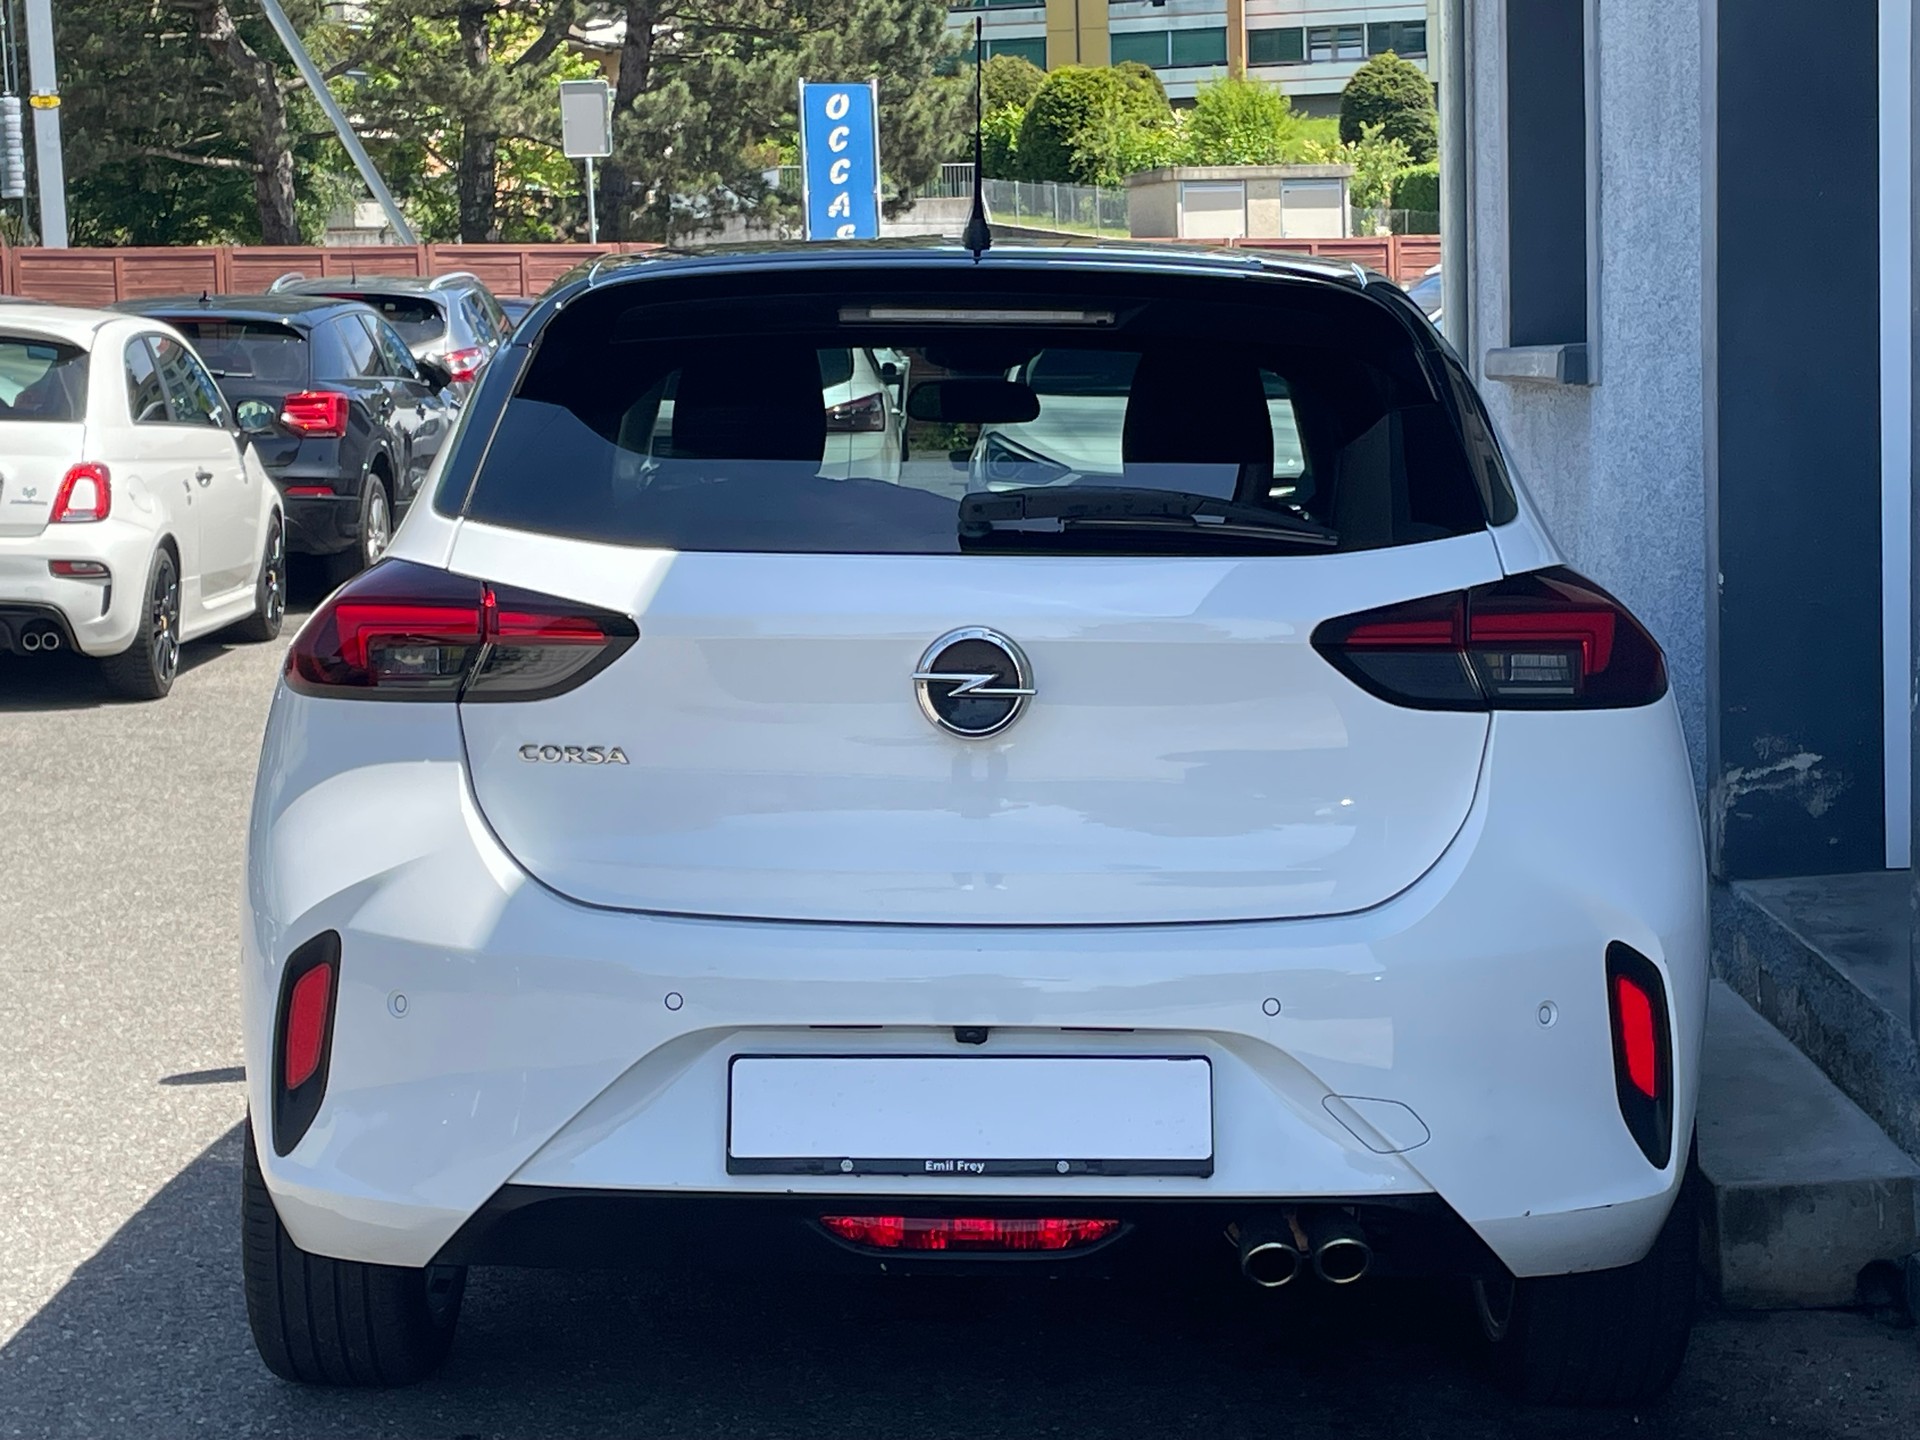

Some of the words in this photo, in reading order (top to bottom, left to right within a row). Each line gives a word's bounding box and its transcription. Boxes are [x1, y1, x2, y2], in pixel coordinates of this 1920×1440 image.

[519, 744, 630, 765] CORSA
[925, 1160, 954, 1171] Emil
[957, 1160, 985, 1174] Frey
